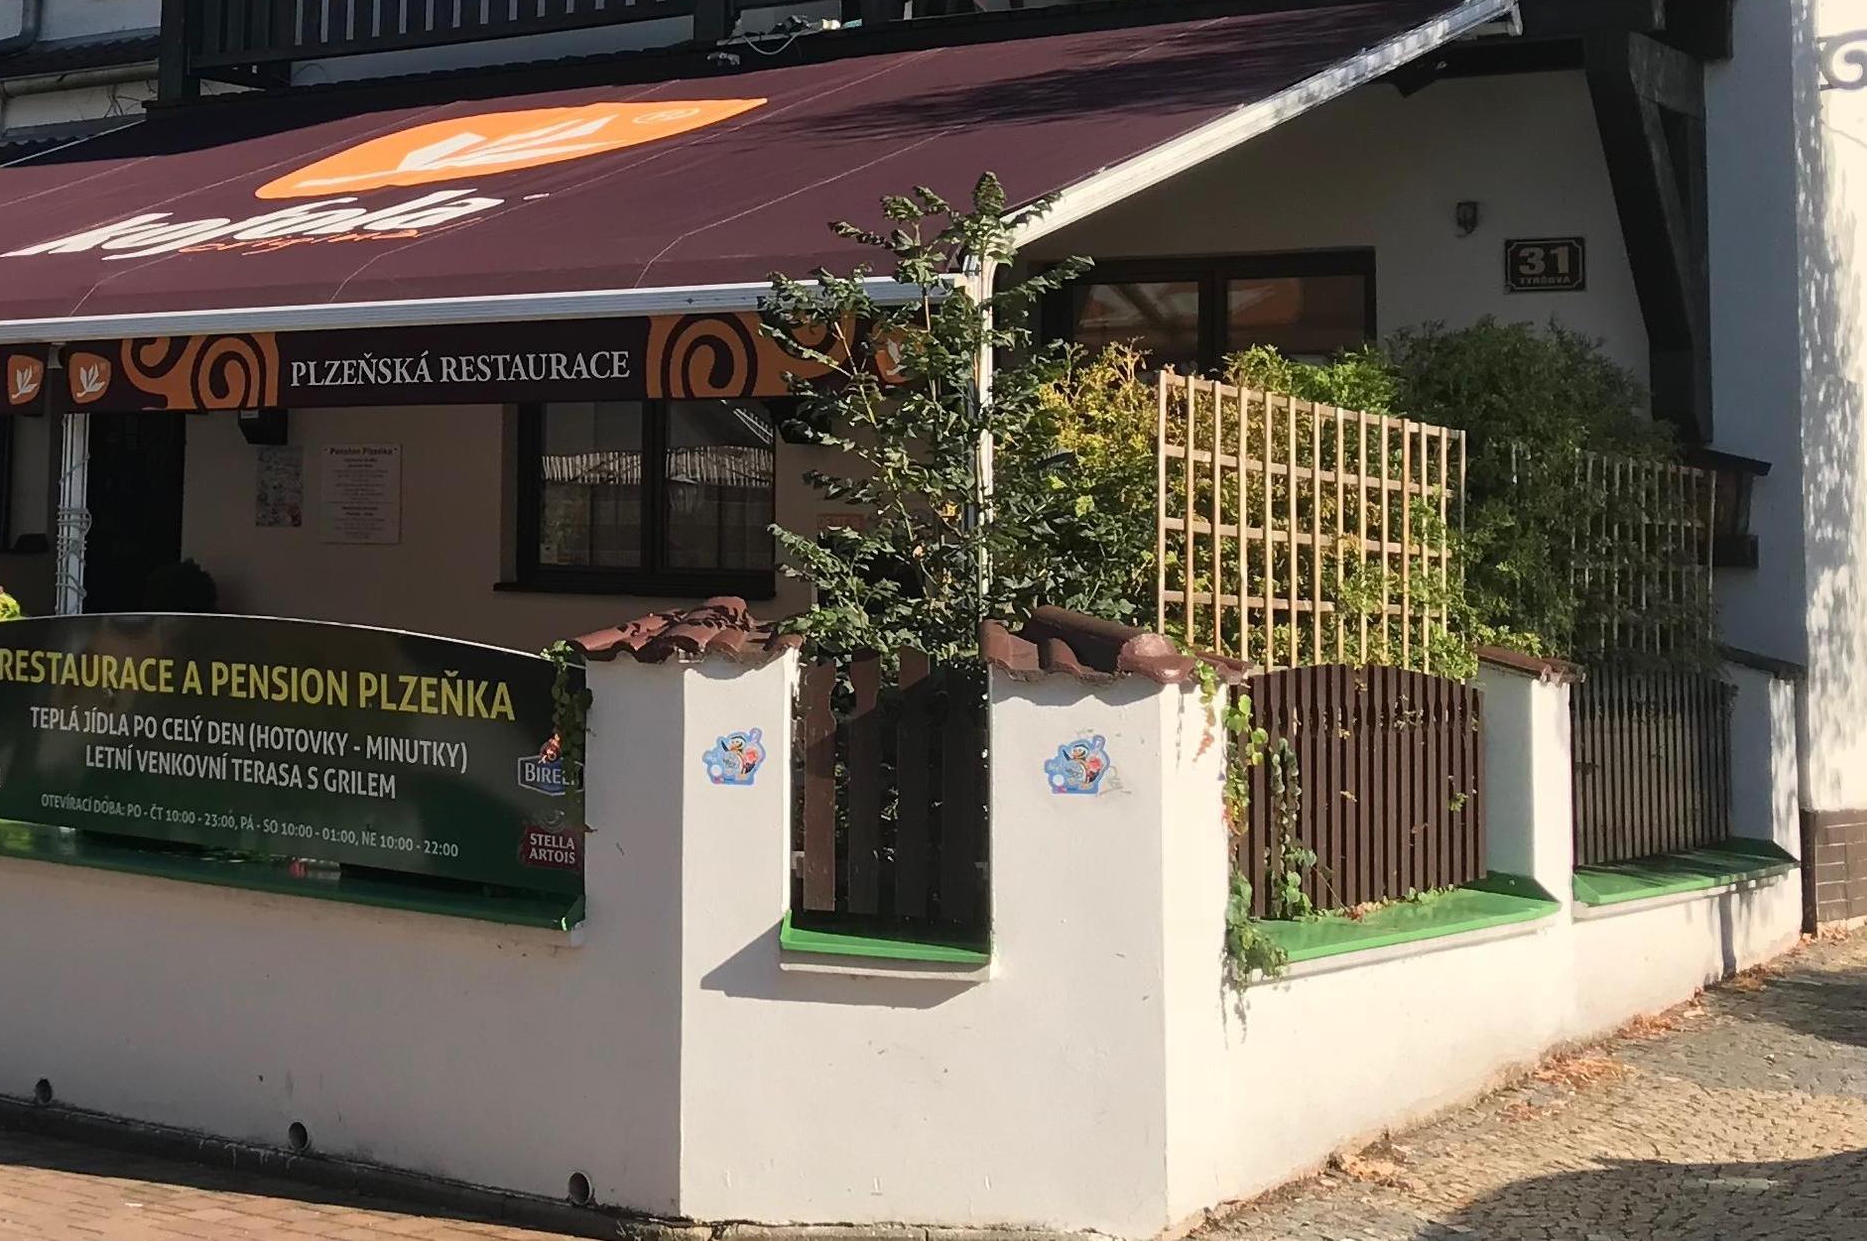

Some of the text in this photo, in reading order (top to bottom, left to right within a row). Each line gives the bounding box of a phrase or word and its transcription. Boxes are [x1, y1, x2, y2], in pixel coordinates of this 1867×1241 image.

[0, 189, 505, 260] Kofola
[1518, 246, 1570, 275] 31
[290, 350, 630, 387] PLZEŇSKÁ RESTAURACE
[182, 660, 203, 695] A
[212, 661, 348, 708] PENSION
[359, 669, 516, 721] PLZEŇKA
[30, 705, 79, 732] TEPLÁ
[82, 707, 129, 737] JÍDLA
[134, 715, 158, 738] PO
[162, 715, 202, 744] CELÝ
[208, 721, 244, 747] DEN
[249, 723, 348, 758] (HOTOVKY
[366, 735, 469, 775] MINUTKY)
[86, 744, 396, 799] LETNÍ VENKOVNÍ TERASA S GRILEM
[525, 761, 575, 786] BIREL
[41, 793, 92, 812] OTEVÍRACÍ
[94, 799, 125, 816] DOBA:
[127, 803, 142, 818] PO
[150, 803, 163, 820] ČT
[166, 809, 195, 824] 10:00
[241, 814, 254, 831] PÁ
[263, 819, 278, 834] SO
[281, 822, 313, 838] 10:00
[362, 831, 377, 846] NE
[380, 835, 413, 851] 10:00
[424, 840, 459, 857] 22:00
[530, 833, 574, 849] STELLA
[529, 847, 576, 865] ARTOIS
